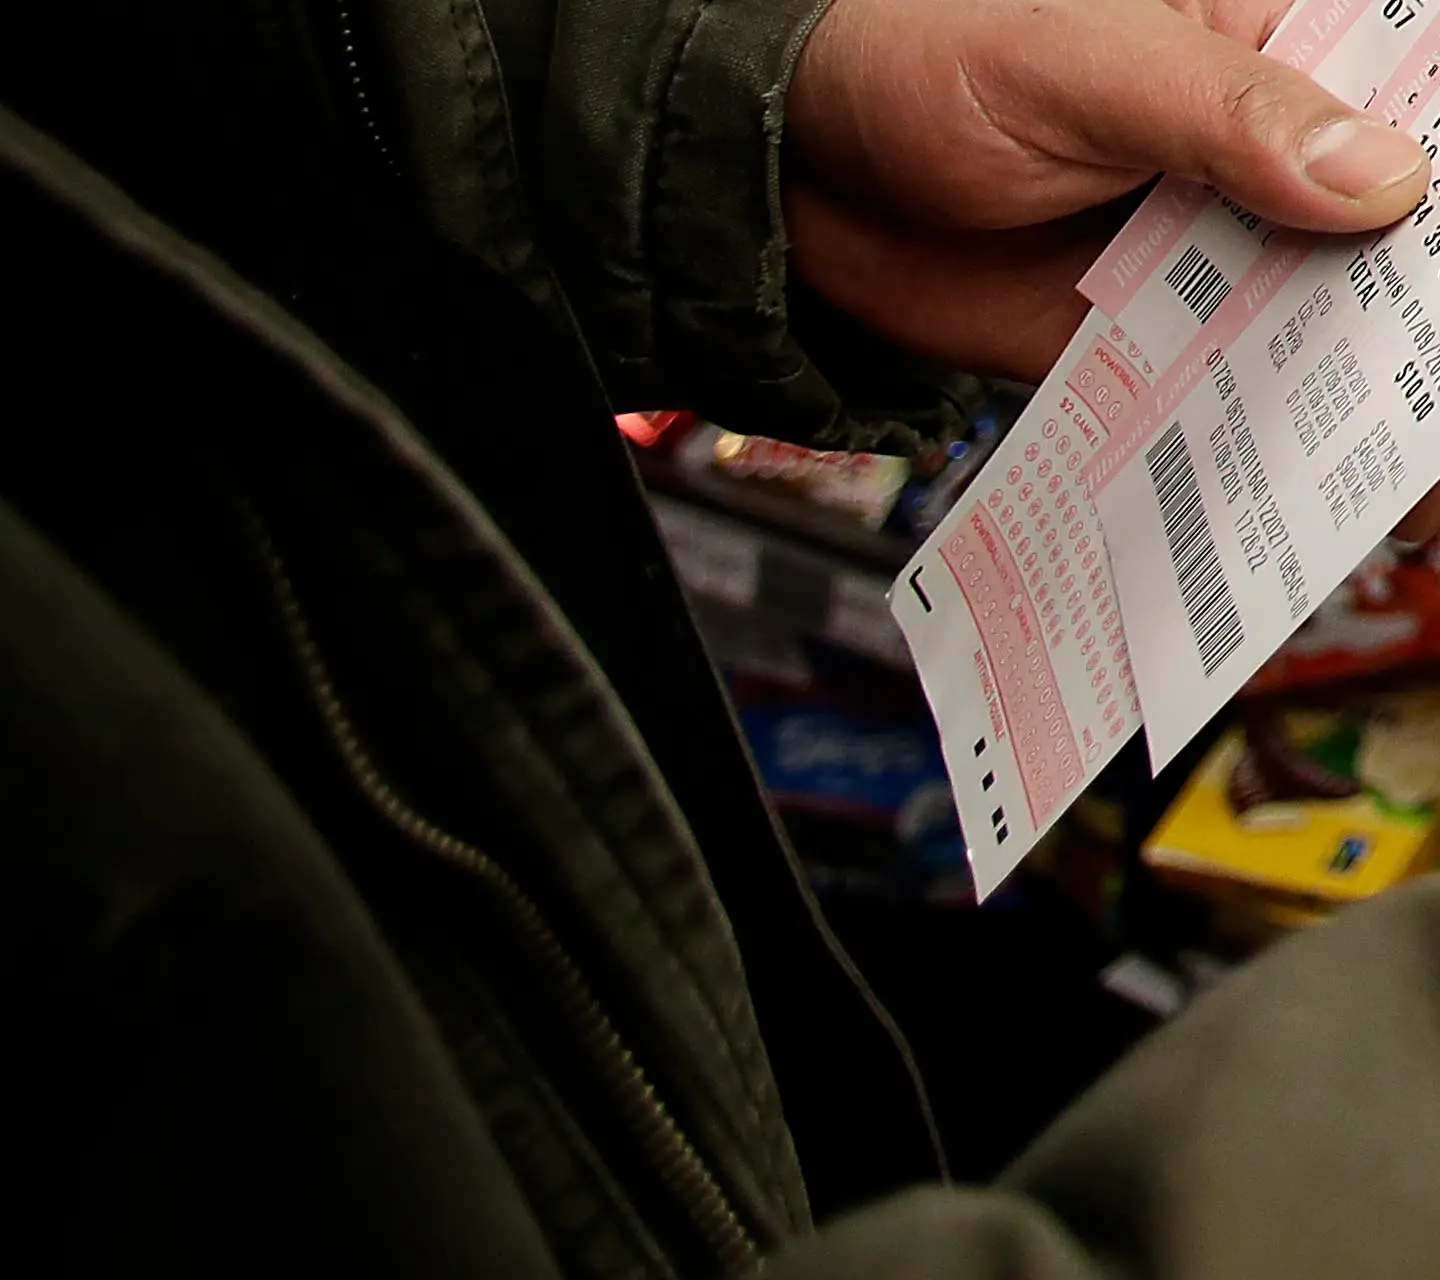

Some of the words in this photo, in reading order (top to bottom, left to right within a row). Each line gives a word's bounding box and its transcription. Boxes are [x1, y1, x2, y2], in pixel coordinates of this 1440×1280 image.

[1374, 246, 1411, 307] draw(s)
[1206, 348, 1236, 400] 017268
[1312, 281, 1332, 316] LOTO
[1388, 455, 1406, 491] MILL
[1318, 354, 1354, 422] 01/09/2016
[1342, 248, 1379, 311] TOTAL
[1394, 361, 1434, 422] $10.00
[1209, 423, 1243, 504] 01/09/2016
[1268, 334, 1287, 373] MEGA
[1286, 388, 1320, 457] 01/12/2016
[1329, 494, 1350, 531] MILL
[1302, 372, 1337, 439] 01/09/2016
[1335, 455, 1359, 489] $900
[1350, 482, 1369, 519] MILL
